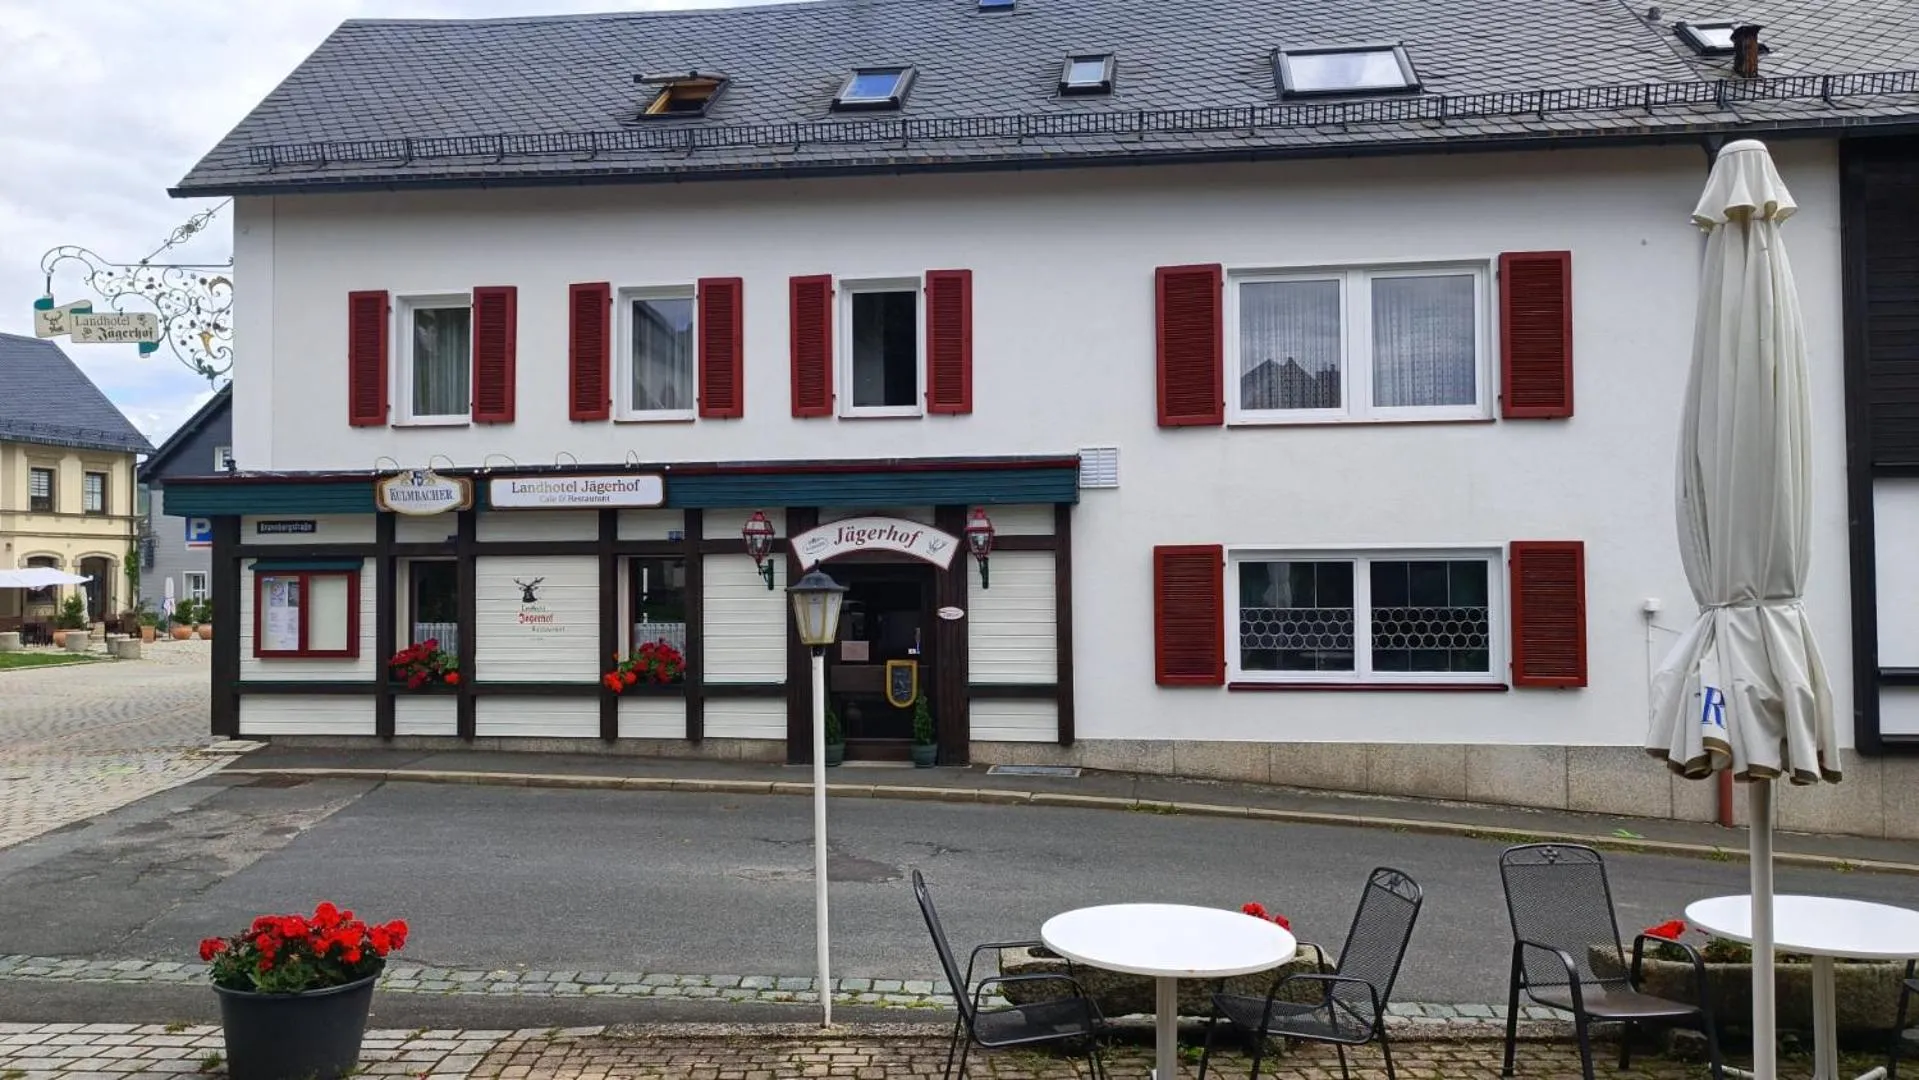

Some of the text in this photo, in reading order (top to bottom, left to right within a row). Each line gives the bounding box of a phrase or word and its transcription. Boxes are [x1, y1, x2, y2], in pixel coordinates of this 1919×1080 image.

[75, 315, 130, 326] Landhotel
[98, 327, 153, 341] Jägerhof
[512, 479, 640, 494] Landhotel Jägerhof
[389, 488, 453, 501] KULMBACHER
[567, 494, 610, 502] Restaurant
[190, 517, 211, 540] P
[833, 524, 923, 548] Jägerhof
